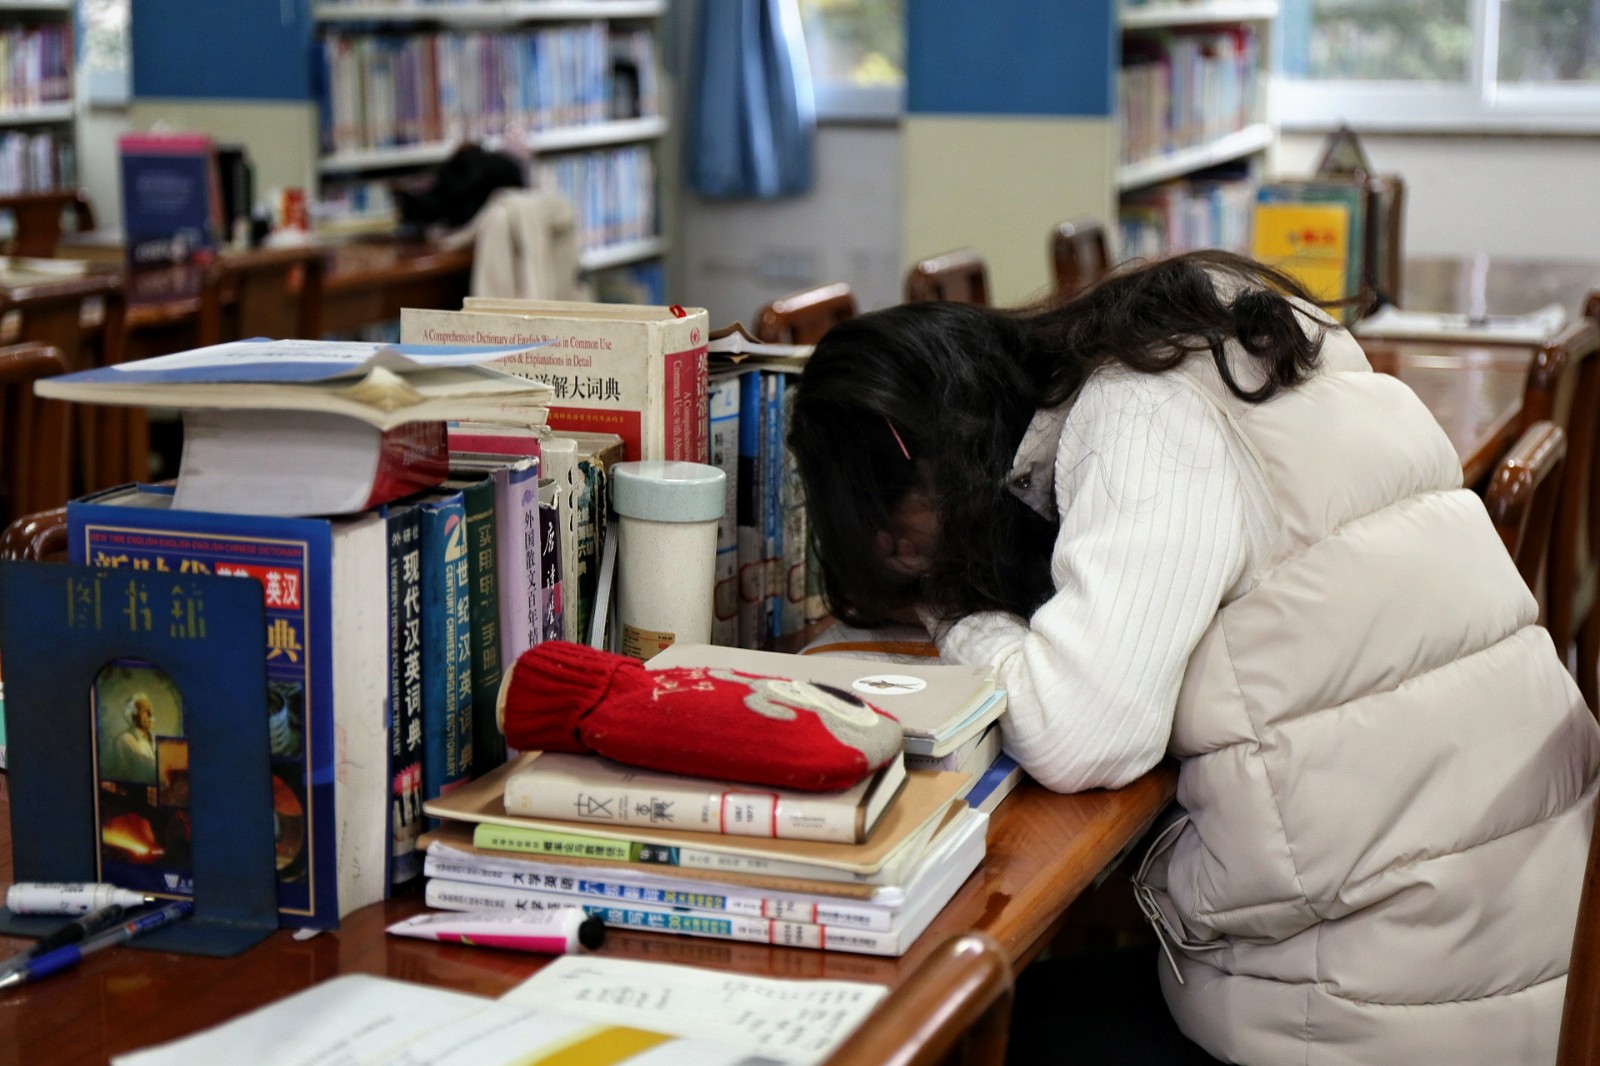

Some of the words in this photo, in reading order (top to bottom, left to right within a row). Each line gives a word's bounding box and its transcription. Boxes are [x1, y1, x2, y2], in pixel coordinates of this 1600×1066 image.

[422, 329, 429, 340] A
[429, 329, 475, 344] Comprehensive
[476, 331, 508, 345] Dictionary
[509, 332, 516, 344] of
[561, 337, 569, 348] in
[570, 338, 598, 350] Common
[600, 339, 612, 351] Use
[525, 353, 564, 367] Explanations
[565, 355, 574, 367] in
[575, 355, 592, 368] Detail
[266, 570, 299, 605] 英汉
[402, 548, 422, 752] 现代汉英词典
